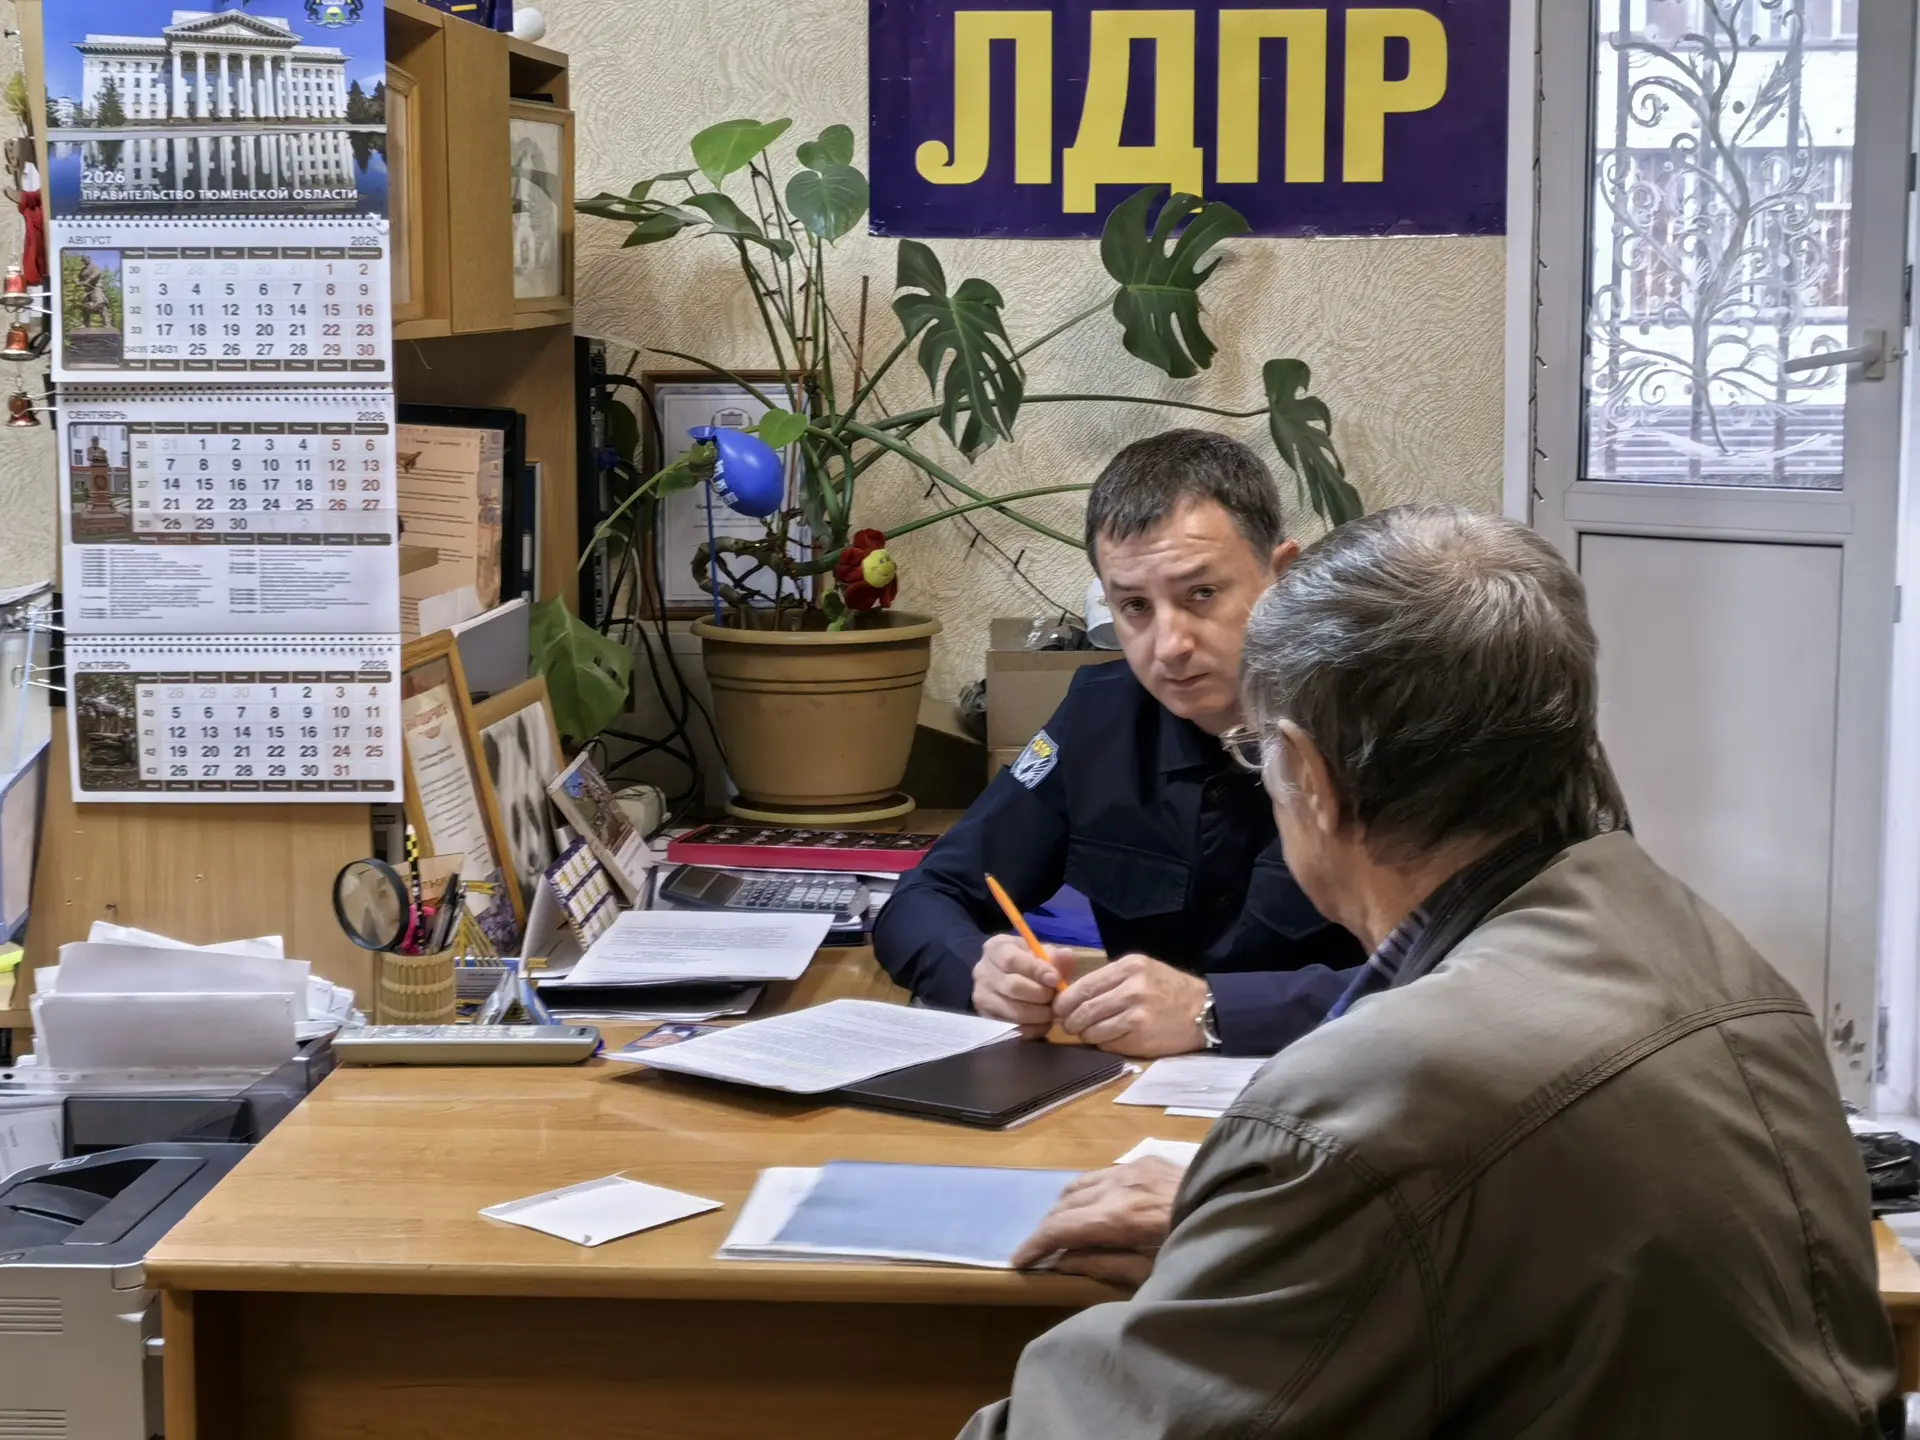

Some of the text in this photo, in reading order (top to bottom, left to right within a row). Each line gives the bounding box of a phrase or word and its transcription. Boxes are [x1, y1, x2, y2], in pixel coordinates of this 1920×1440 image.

[915, 8, 1448, 213] ЛДПР
[83, 172, 125, 183] 2026
[83, 187, 358, 200] ПРАВИТЕЛЬСТВО ТЮМЕНСКОЙ ОБЛАСТИ
[68, 236, 111, 244] АВГУСТ
[327, 264, 332, 275] 1
[359, 264, 368, 275] 2
[159, 283, 168, 295] 3
[192, 284, 200, 295] 4
[225, 284, 234, 295] 5
[259, 284, 268, 295] 6
[292, 284, 302, 295] 7
[326, 284, 335, 295] 8
[359, 284, 368, 295] 9
[156, 304, 173, 315] 10
[189, 304, 204, 315] 11
[222, 304, 239, 315] 12
[256, 304, 273, 315] 13
[289, 304, 306, 315] 14
[323, 304, 340, 316] 15
[356, 304, 374, 316] 16
[157, 324, 173, 335] 17
[189, 324, 207, 335] 18
[223, 324, 240, 336] 19
[256, 324, 274, 336] 20
[289, 324, 305, 336] 21
[322, 324, 340, 336] 22
[356, 324, 374, 336] 23
[189, 344, 207, 355] 25
[223, 344, 241, 355] 26
[256, 344, 274, 355] 27
[290, 344, 308, 355] 28
[323, 344, 341, 355] 29
[357, 344, 374, 355] 30
[199, 439, 205, 450] 1
[232, 439, 240, 450] 2
[265, 439, 274, 450] 3
[298, 439, 308, 450] 4
[332, 439, 341, 450] 5
[366, 439, 375, 450] 6
[166, 459, 175, 470] 7
[199, 459, 208, 470] 8
[232, 459, 241, 470] 9
[262, 459, 279, 471] 10
[296, 459, 310, 471] 11
[329, 460, 346, 471] 12
[362, 460, 379, 471] 13
[163, 478, 180, 490] 14
[196, 479, 213, 490] 15
[229, 479, 246, 490] 16
[262, 479, 279, 490] 17
[296, 479, 313, 490] 18
[329, 479, 346, 491] 19
[362, 480, 380, 491] 20
[164, 498, 180, 509] 21
[196, 499, 214, 509] 22
[229, 499, 247, 510] 23
[262, 499, 280, 510] 24
[296, 499, 313, 510] 25
[329, 499, 347, 510] 26
[362, 499, 380, 511] 27
[195, 518, 214, 529] 29
[229, 518, 247, 530] 30
[270, 687, 277, 698] 1
[303, 687, 312, 698] 2
[336, 687, 345, 698] 3
[368, 687, 377, 697] 4
[172, 707, 181, 718] 5
[204, 707, 213, 718] 6
[237, 707, 246, 718] 7
[270, 707, 279, 718] 8
[303, 707, 312, 718] 9
[332, 706, 350, 718] 10
[366, 706, 380, 718] 11
[169, 727, 186, 738] 12
[201, 727, 218, 738] 13
[234, 726, 251, 737] 14
[267, 726, 284, 737] 15
[300, 726, 317, 737] 16
[333, 726, 350, 737] 17
[366, 726, 383, 737] 18
[170, 746, 187, 757] 19
[202, 746, 219, 757] 20
[234, 746, 250, 757] 21
[267, 746, 285, 757] 22
[300, 746, 318, 757] 23
[333, 746, 351, 757] 24
[365, 746, 383, 757] 25
[170, 765, 188, 776] 26
[202, 765, 220, 776] 27
[235, 765, 253, 776] 28
[268, 765, 286, 776] 29
[301, 765, 318, 776] 30
[333, 765, 350, 776] 31
